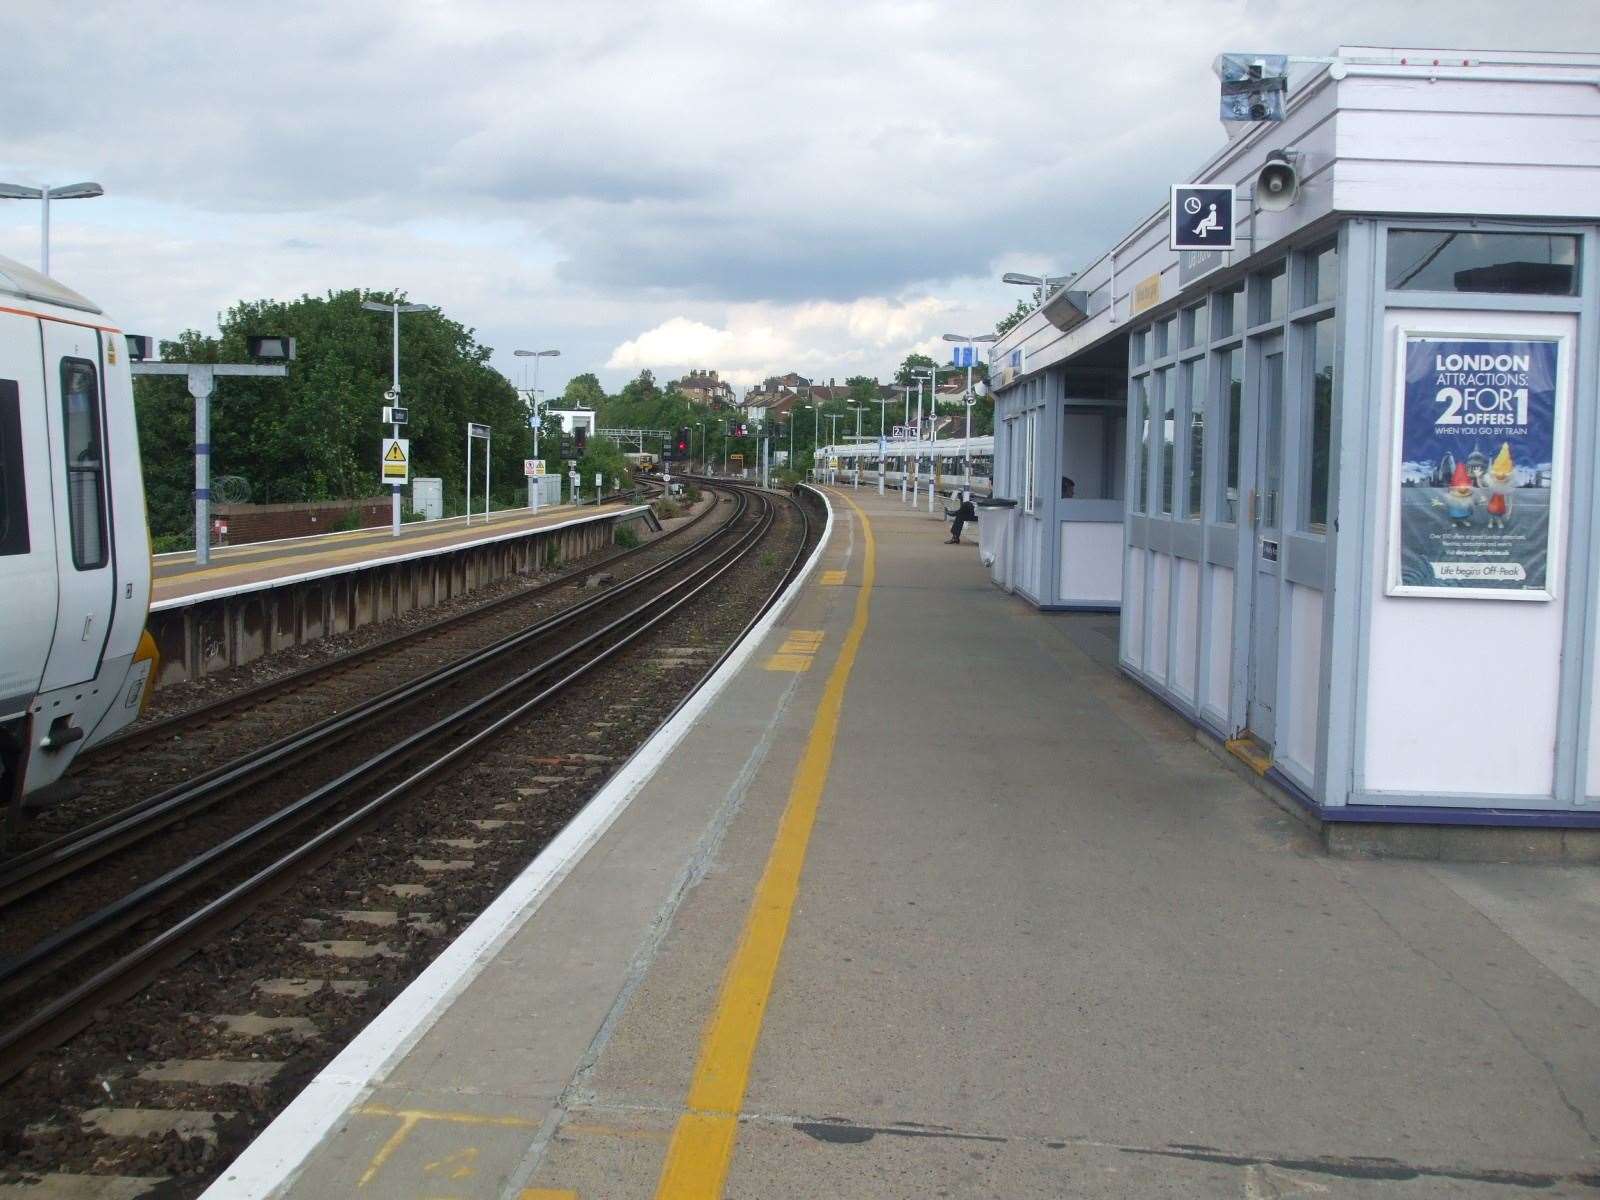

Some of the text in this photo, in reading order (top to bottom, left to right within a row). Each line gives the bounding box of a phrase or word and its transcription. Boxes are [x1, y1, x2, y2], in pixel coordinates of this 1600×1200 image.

[1435, 354, 1530, 372] LONDON
[1436, 373, 1529, 386] ATTRACTIONS:
[1434, 387, 1529, 425] 2 FOR 1
[1464, 413, 1514, 425] OFFERS
[1435, 427, 1528, 435] WHEN YOU GO BY TRAIN
[1440, 565, 1454, 575] Life
